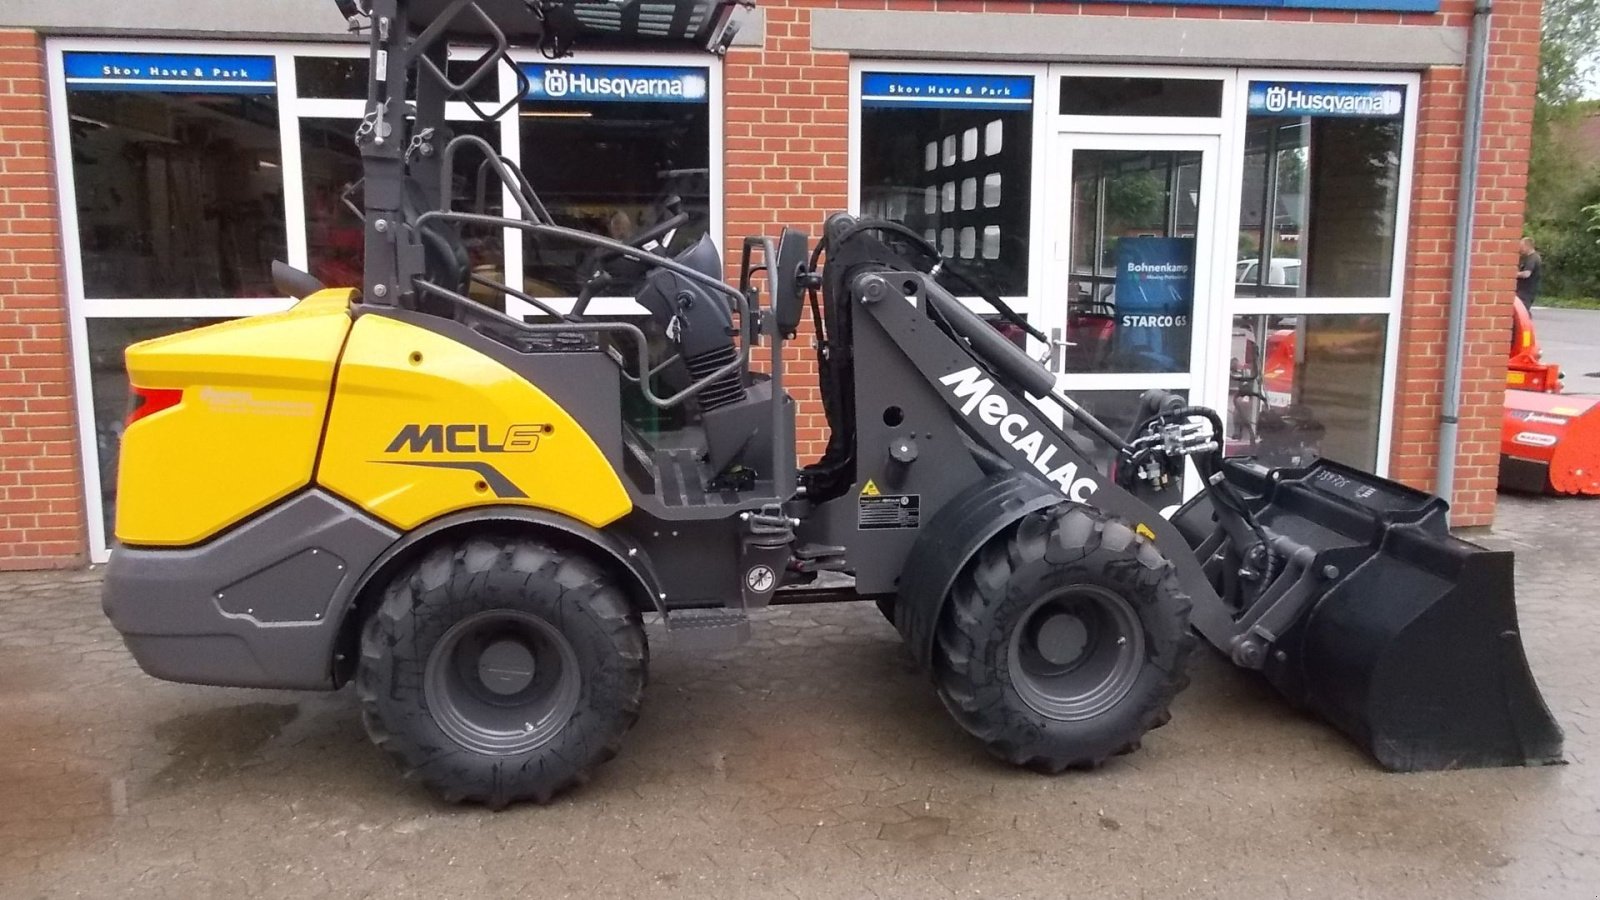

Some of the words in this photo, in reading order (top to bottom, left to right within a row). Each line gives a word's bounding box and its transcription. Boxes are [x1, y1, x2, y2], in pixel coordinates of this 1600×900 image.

[103, 66, 141, 76] Skov
[149, 67, 188, 77] Have
[194, 67, 204, 77] &
[212, 68, 249, 78] Park
[569, 73, 683, 98] Husqvarna
[888, 84, 921, 94] Skov
[928, 85, 960, 95] Have
[965, 86, 973, 95] &
[980, 86, 1011, 96] Park
[1286, 90, 1384, 113] Husqvarna
[1127, 262, 1189, 273] Bohnenkamp
[1122, 315, 1173, 327] STARCO
[1174, 315, 1187, 327] GS
